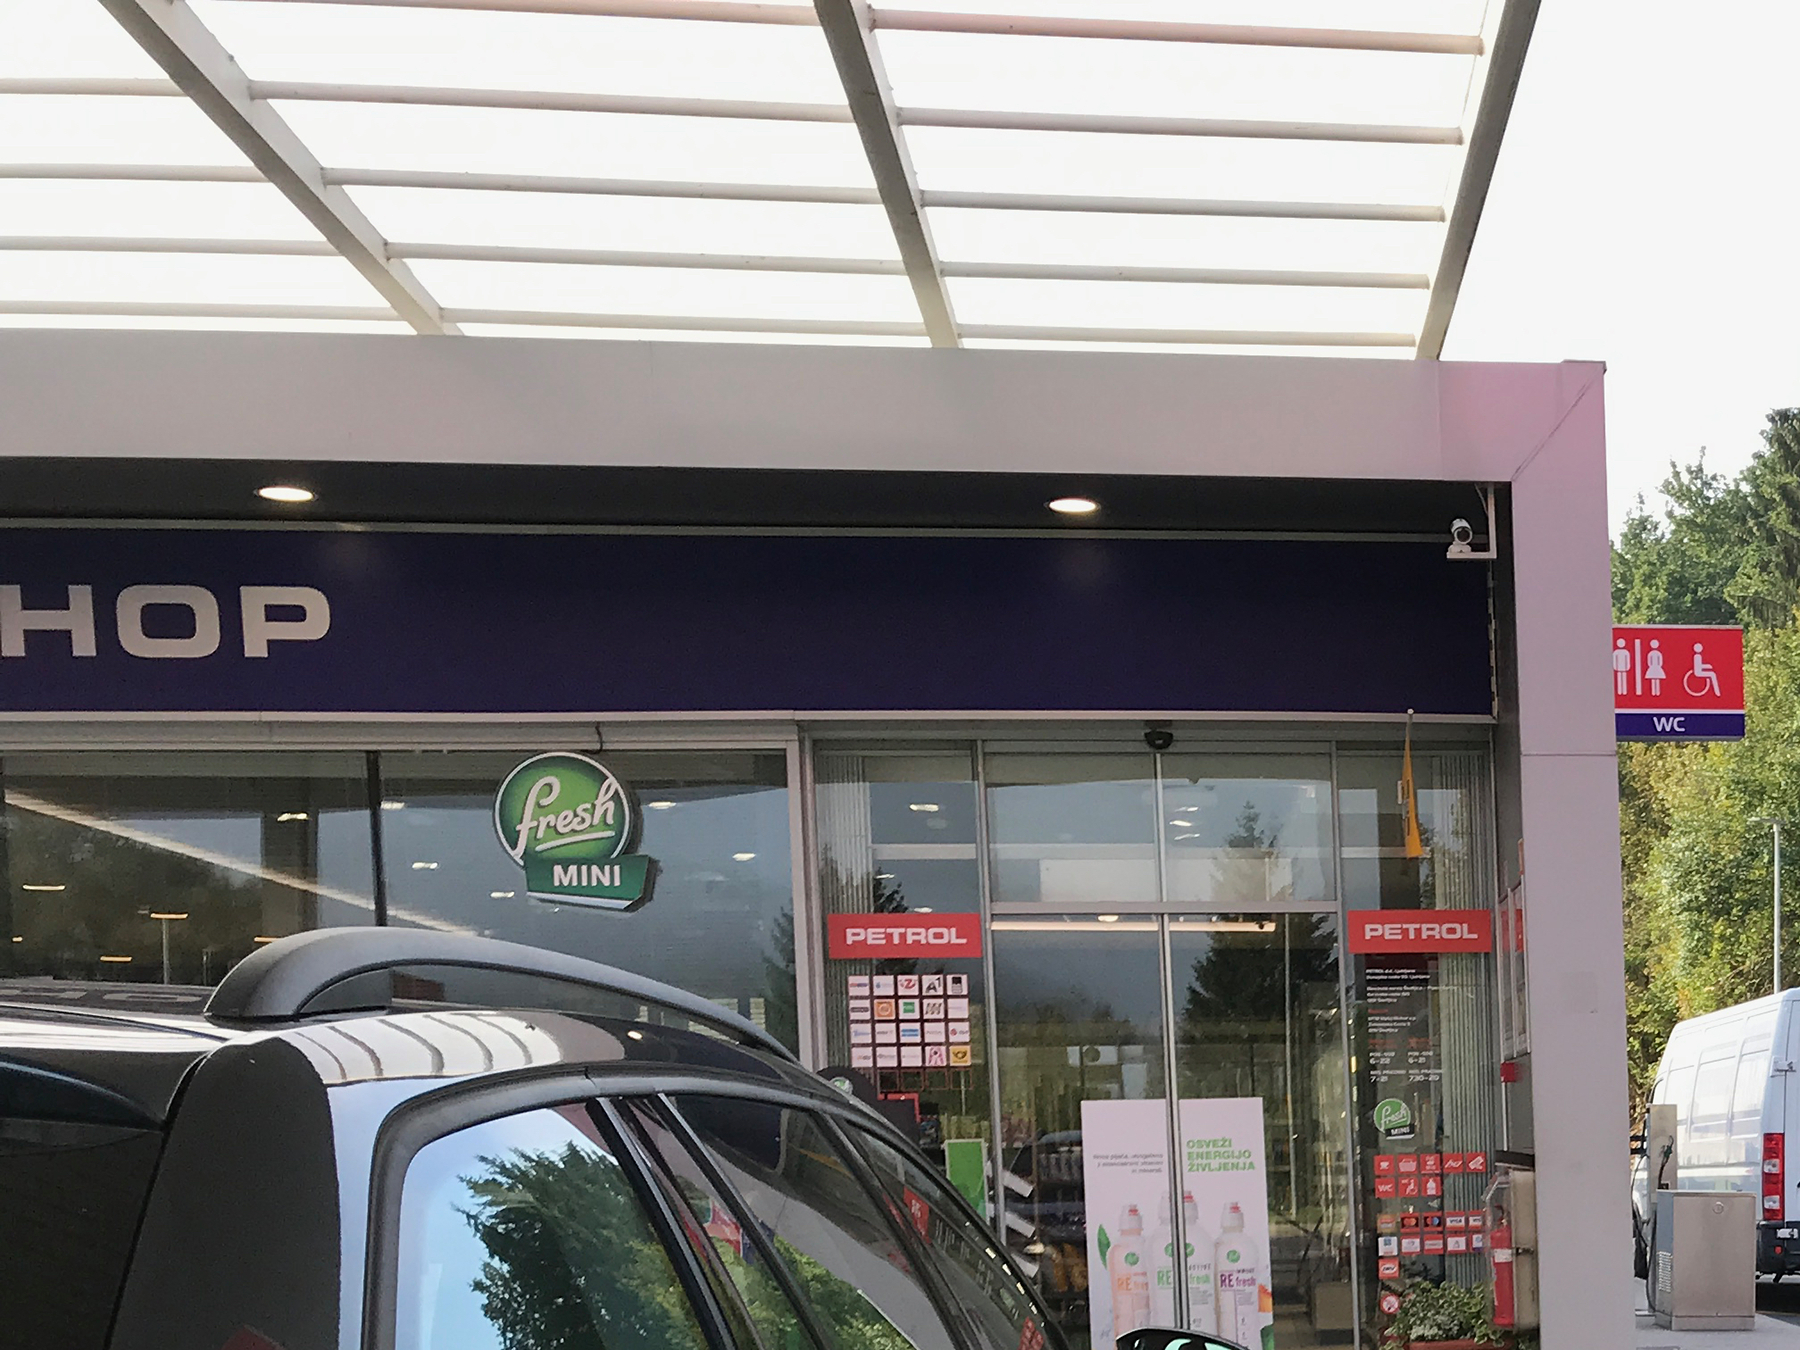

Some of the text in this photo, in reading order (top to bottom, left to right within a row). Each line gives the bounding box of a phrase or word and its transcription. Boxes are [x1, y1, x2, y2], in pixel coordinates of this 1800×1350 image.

[0, 584, 330, 658] HOP
[1653, 716, 1685, 732] WC
[513, 776, 619, 857] fresh
[553, 864, 621, 887] MINI
[846, 927, 967, 945] PETROL
[1364, 923, 1478, 940] PETROL
[925, 976, 941, 993] A1
[1391, 1126, 1410, 1136] MINI
[1187, 1137, 1232, 1149] OSVEŽI
[1187, 1150, 1252, 1161] ENERGIJO
[1187, 1161, 1256, 1173] ŽIVLJENJA
[1378, 1184, 1394, 1192] WC
[1448, 1217, 1463, 1225] VISA
[1117, 1277, 1132, 1292] RE
[1157, 1270, 1172, 1286] RE
[1220, 1274, 1257, 1288] RE fresh
